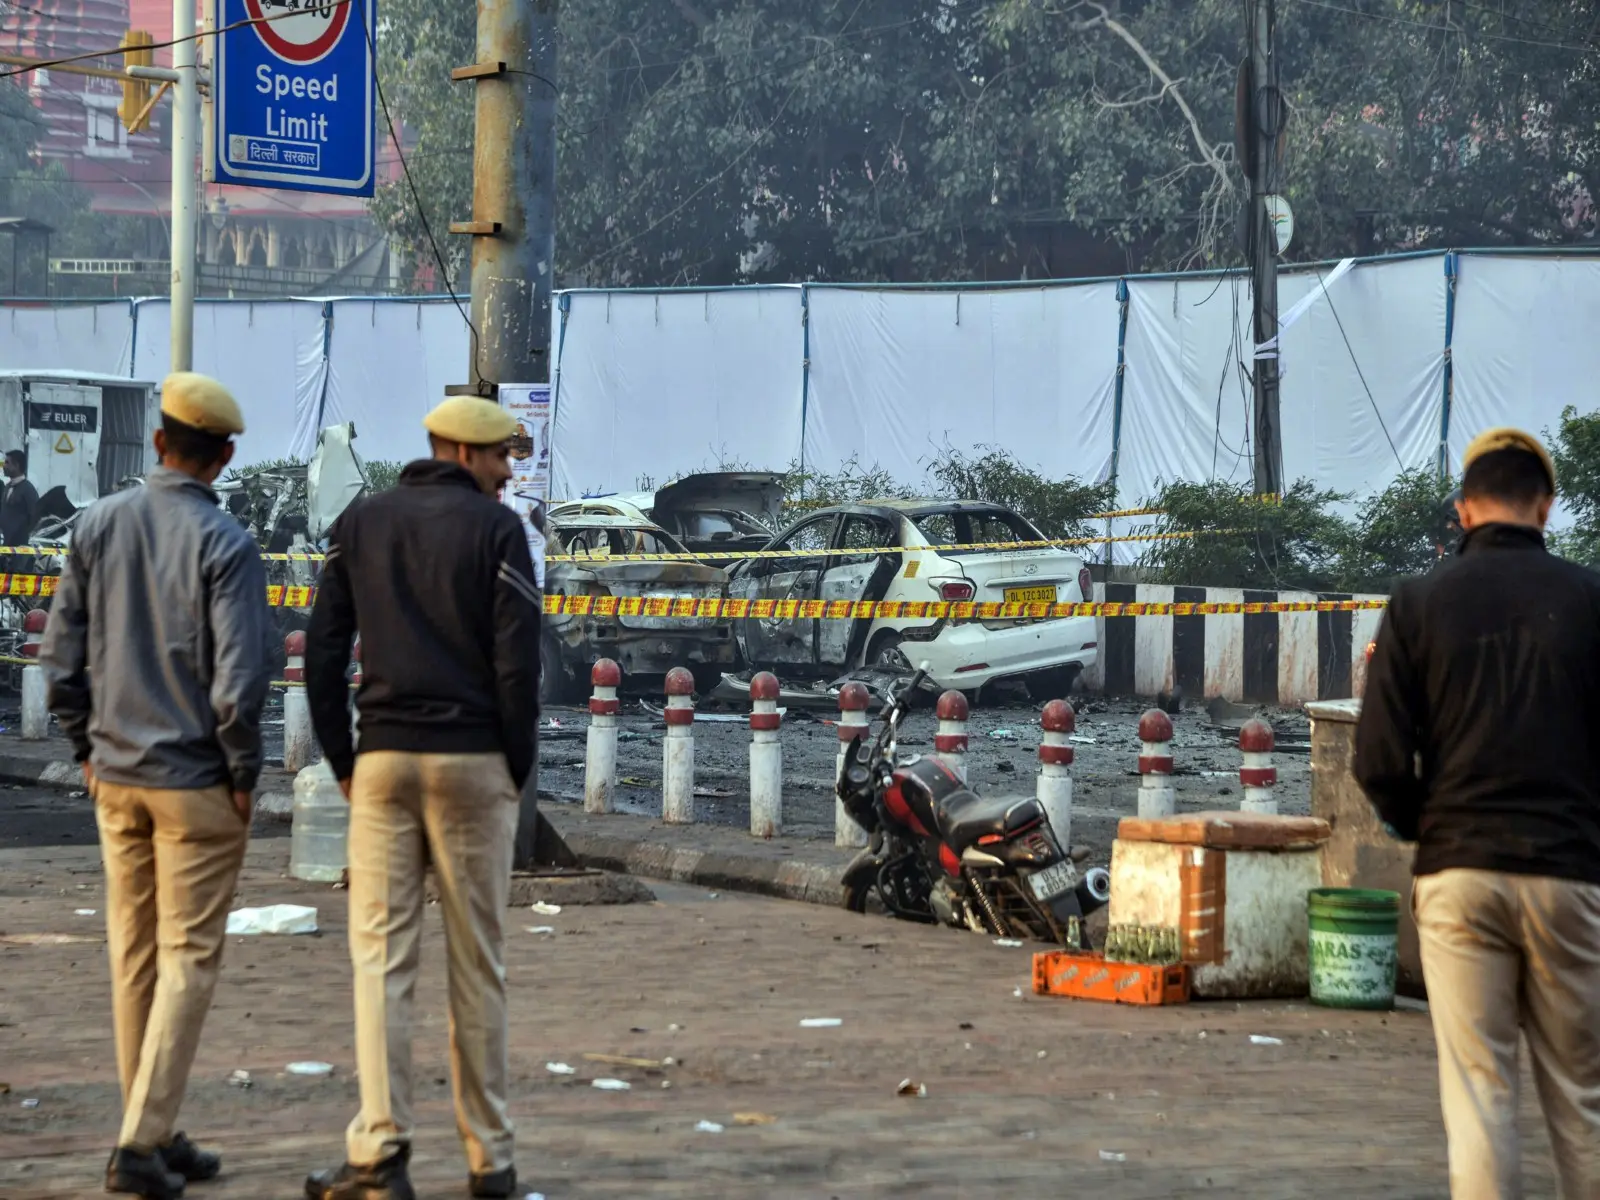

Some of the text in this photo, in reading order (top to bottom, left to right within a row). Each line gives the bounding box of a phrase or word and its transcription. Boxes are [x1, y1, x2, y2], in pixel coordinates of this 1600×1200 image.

[256, 64, 338, 101] Speed
[266, 107, 328, 142] Limit
[250, 142, 316, 165] दिल्ली सरकार
[54, 413, 87, 424] EULER
[1010, 592, 1020, 602] DL
